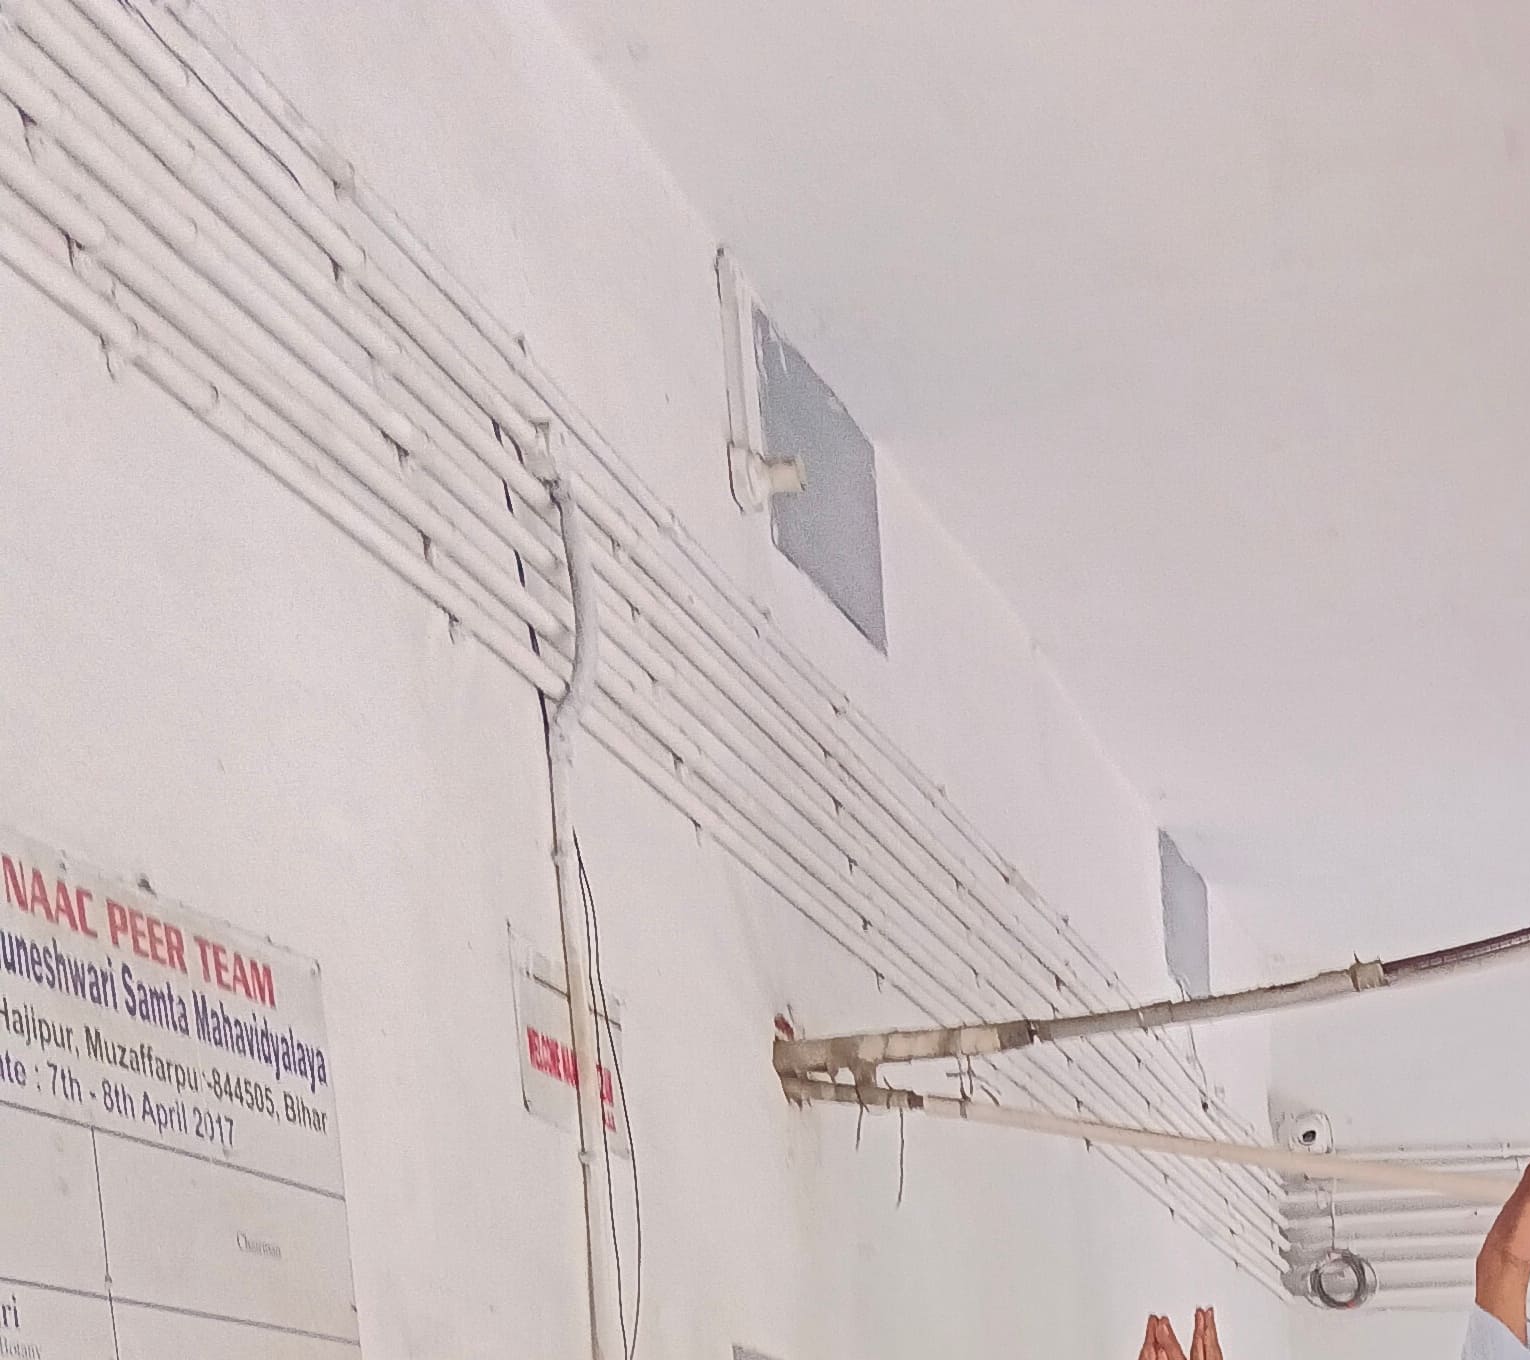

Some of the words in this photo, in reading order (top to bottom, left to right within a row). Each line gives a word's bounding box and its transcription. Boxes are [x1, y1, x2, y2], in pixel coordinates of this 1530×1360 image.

[1, 853, 98, 939] NAAC
[105, 897, 188, 975] PEER
[193, 934, 277, 1010] TEAM
[0, 928, 118, 1011] uneshwari
[121, 965, 190, 1037] Samta
[192, 988, 329, 1094] Mahavidyalaya
[47, 1060, 83, 1104] 7th
[101, 1078, 136, 1120] 8th
[141, 1089, 188, 1137] April
[193, 1105, 235, 1148] 2017
[283, 1088, 328, 1136] Bihar
